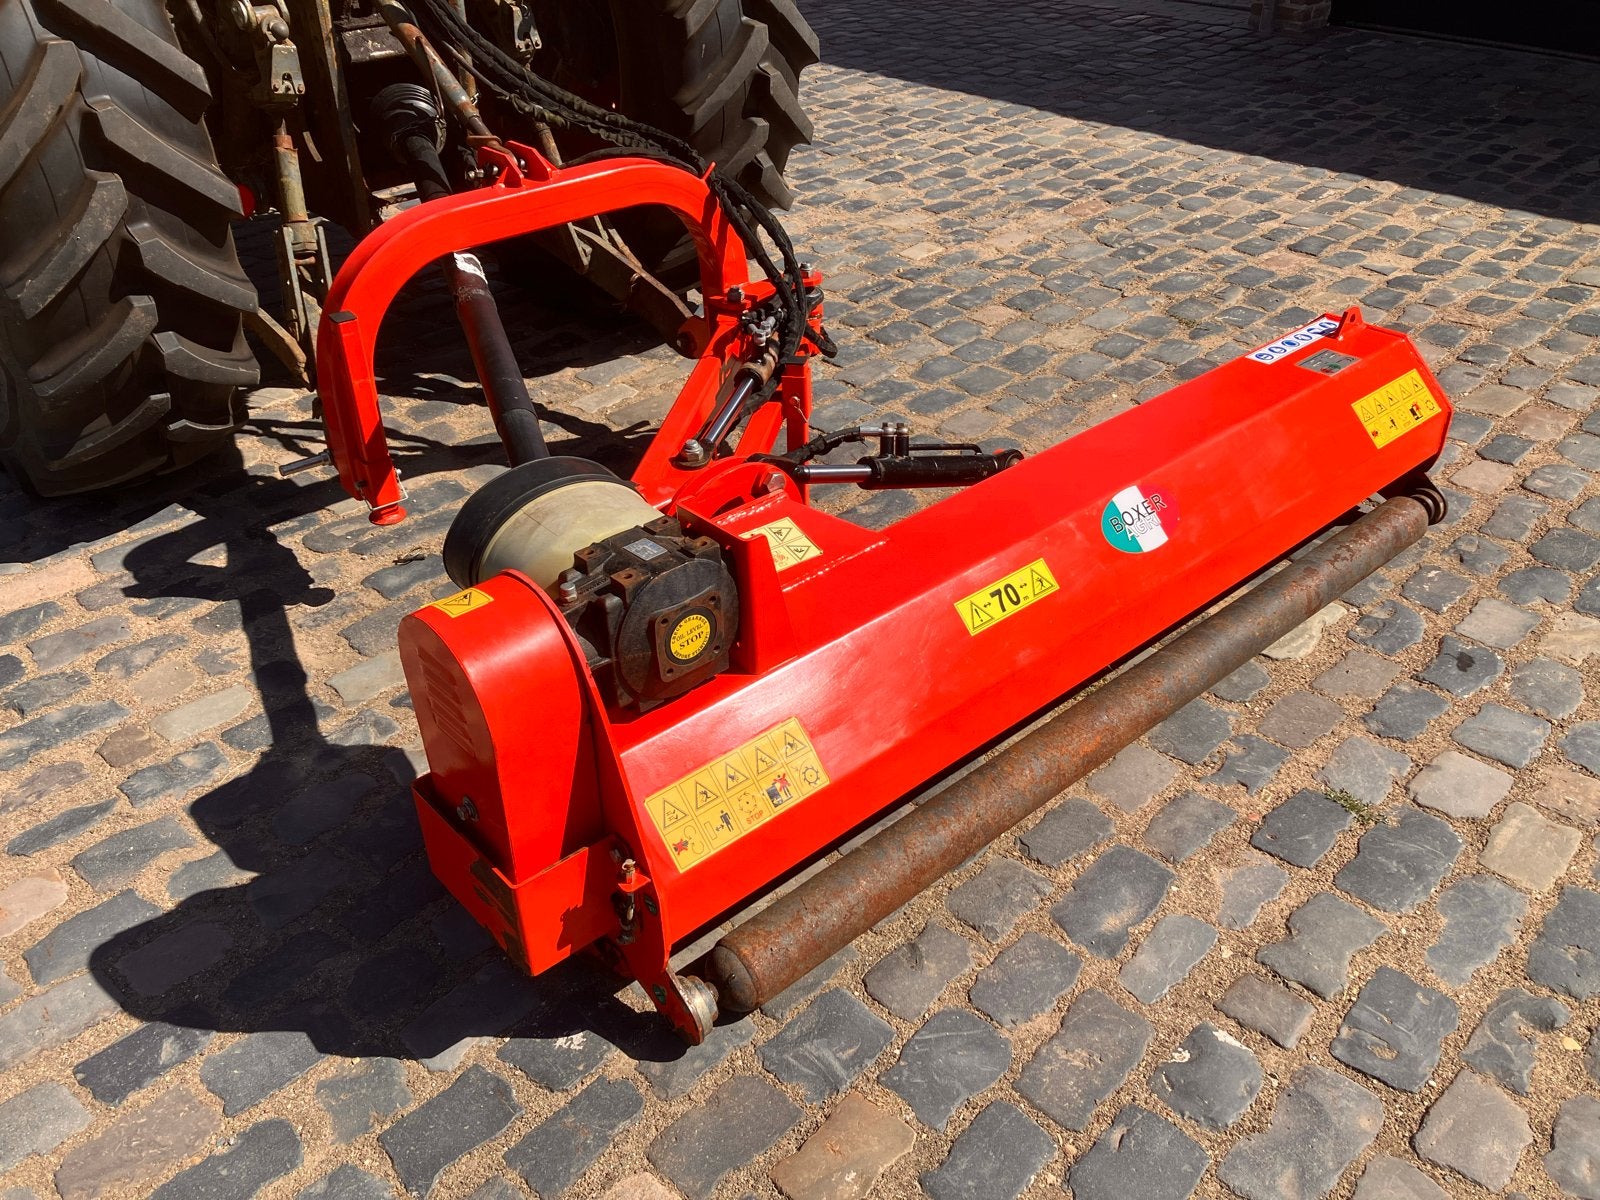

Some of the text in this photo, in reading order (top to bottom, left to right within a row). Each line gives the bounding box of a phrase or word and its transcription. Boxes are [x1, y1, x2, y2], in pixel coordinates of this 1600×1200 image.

[1109, 494, 1167, 533] BOXER
[989, 583, 1021, 613] 70
[679, 630, 704, 650] STOP
[745, 809, 764, 825] STOP
